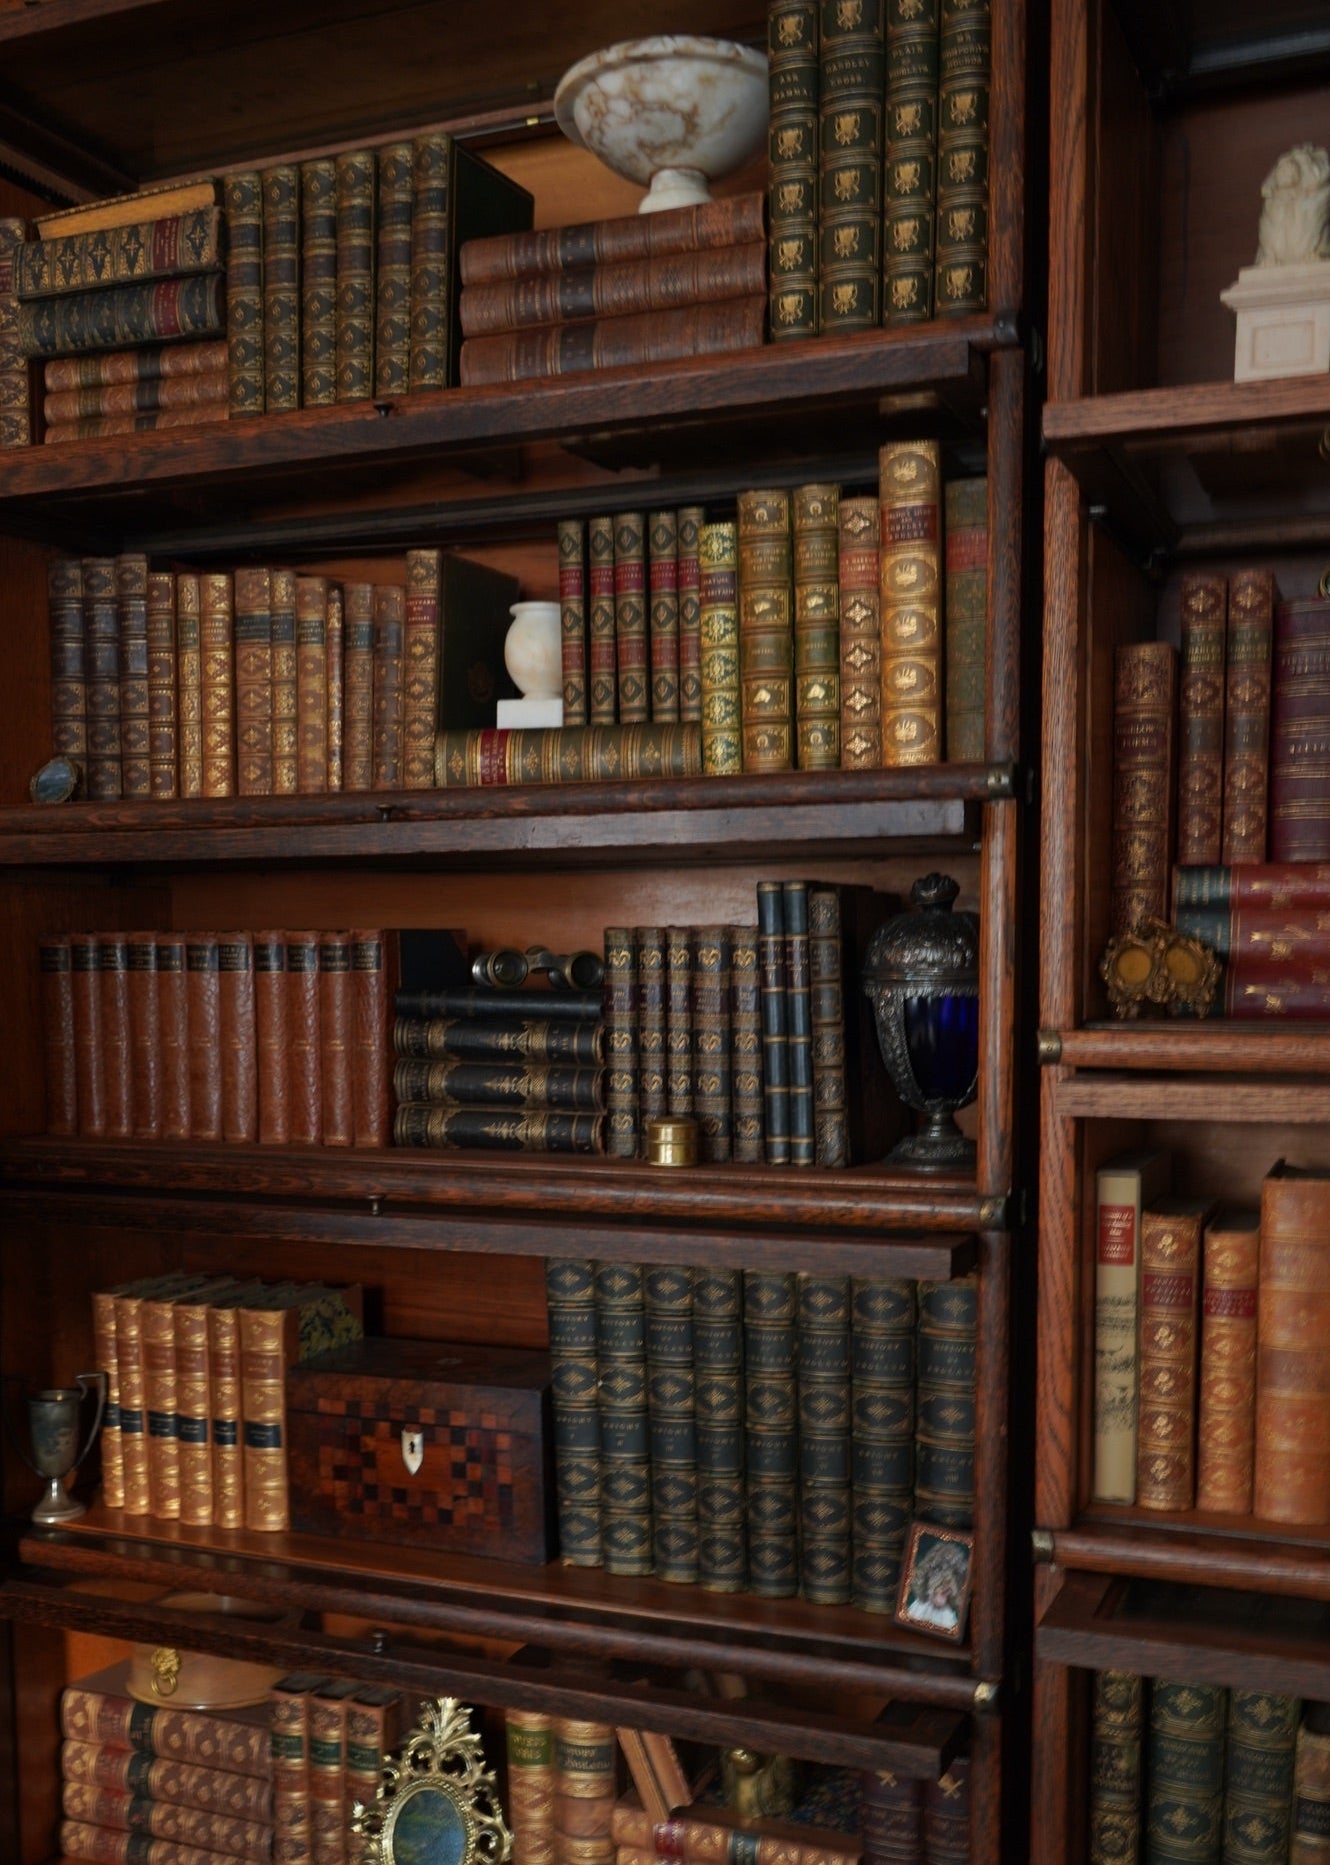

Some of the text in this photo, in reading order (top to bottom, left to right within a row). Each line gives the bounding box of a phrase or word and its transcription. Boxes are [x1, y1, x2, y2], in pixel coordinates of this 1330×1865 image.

[891, 45, 924, 60] PLAIN
[825, 58, 871, 74] HANDLEY
[553, 1314, 589, 1323] HISTORY
[601, 1319, 638, 1327] HISTORY
[649, 1324, 686, 1332] HISTORY
[749, 1334, 786, 1342] HISTORY
[803, 1337, 842, 1345] HISTORY
[598, 1339, 644, 1347] ENGLAND
[861, 1342, 899, 1351] HISTORY
[646, 1344, 693, 1352] ENGLAND
[934, 1344, 975, 1353] HISTORY
[695, 1351, 738, 1359] ENGLAND
[747, 1355, 792, 1363] ENGLAND
[802, 1359, 848, 1368] ENGLAND
[856, 1362, 906, 1370] ENGLAND
